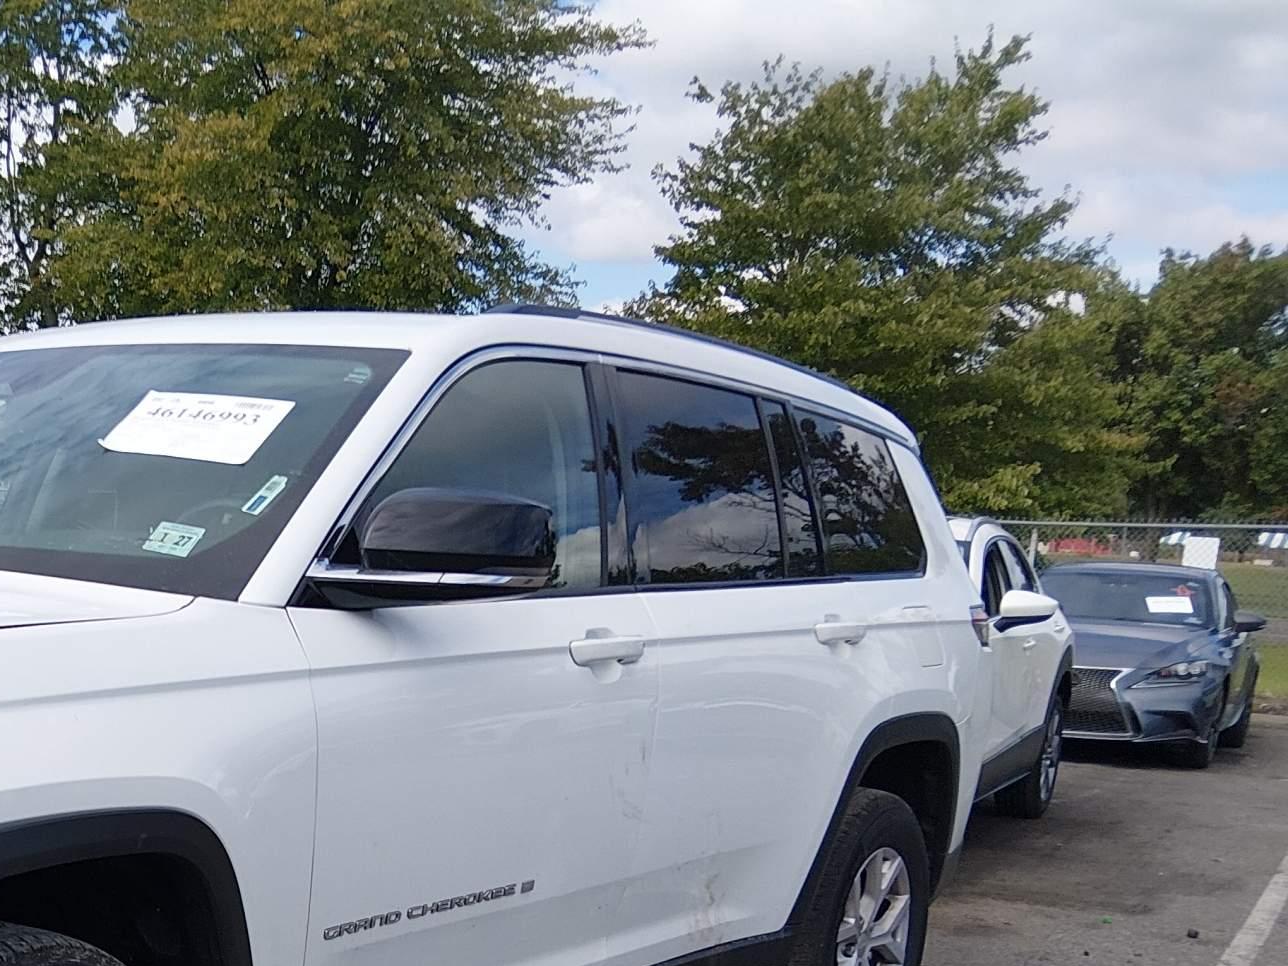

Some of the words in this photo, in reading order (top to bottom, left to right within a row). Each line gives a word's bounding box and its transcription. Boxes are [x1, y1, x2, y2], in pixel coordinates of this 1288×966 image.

[146, 407, 262, 426] 46146993
[173, 535, 193, 547] 27
[323, 910, 402, 941] GRAND
[406, 883, 517, 920] CHEROKEE
